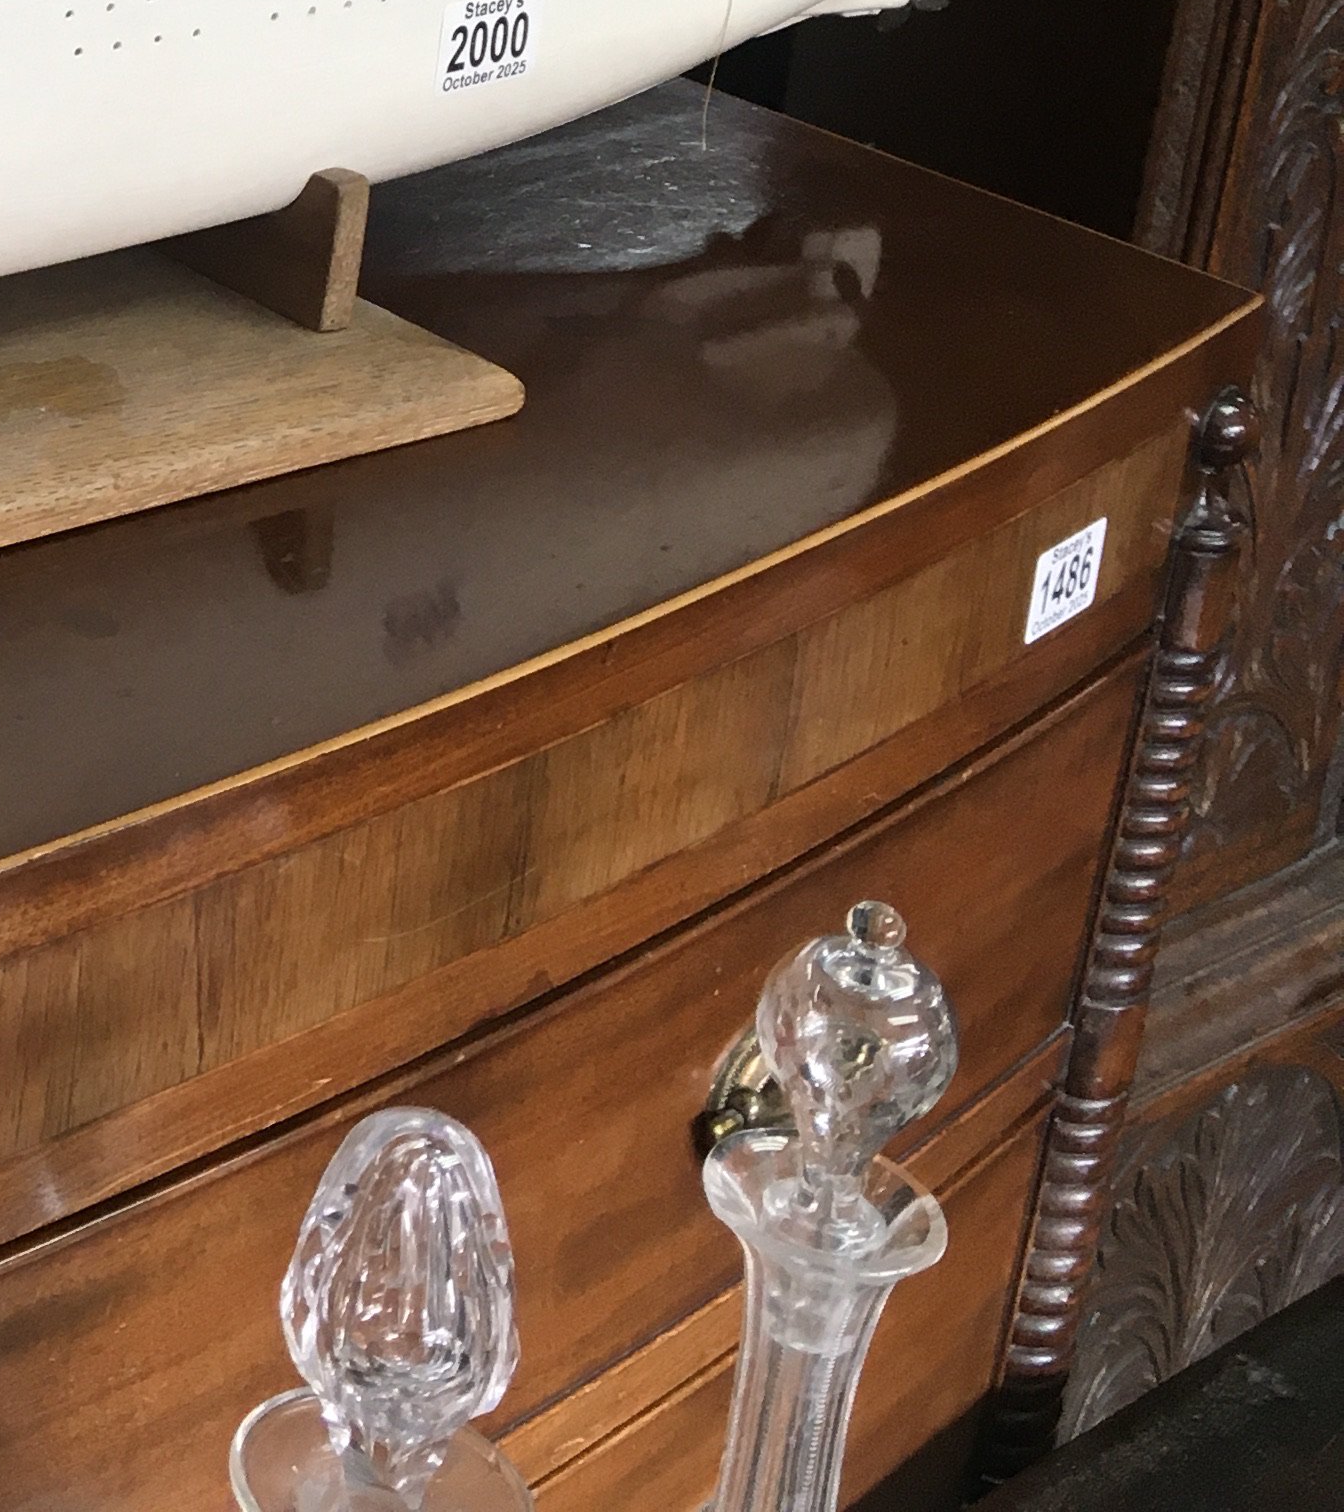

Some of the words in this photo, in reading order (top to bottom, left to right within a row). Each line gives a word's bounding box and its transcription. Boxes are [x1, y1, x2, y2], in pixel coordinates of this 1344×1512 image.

[446, 11, 529, 74] 2000
[442, 69, 494, 93] October
[496, 60, 526, 80] 2025
[1041, 545, 1094, 616] 1486
